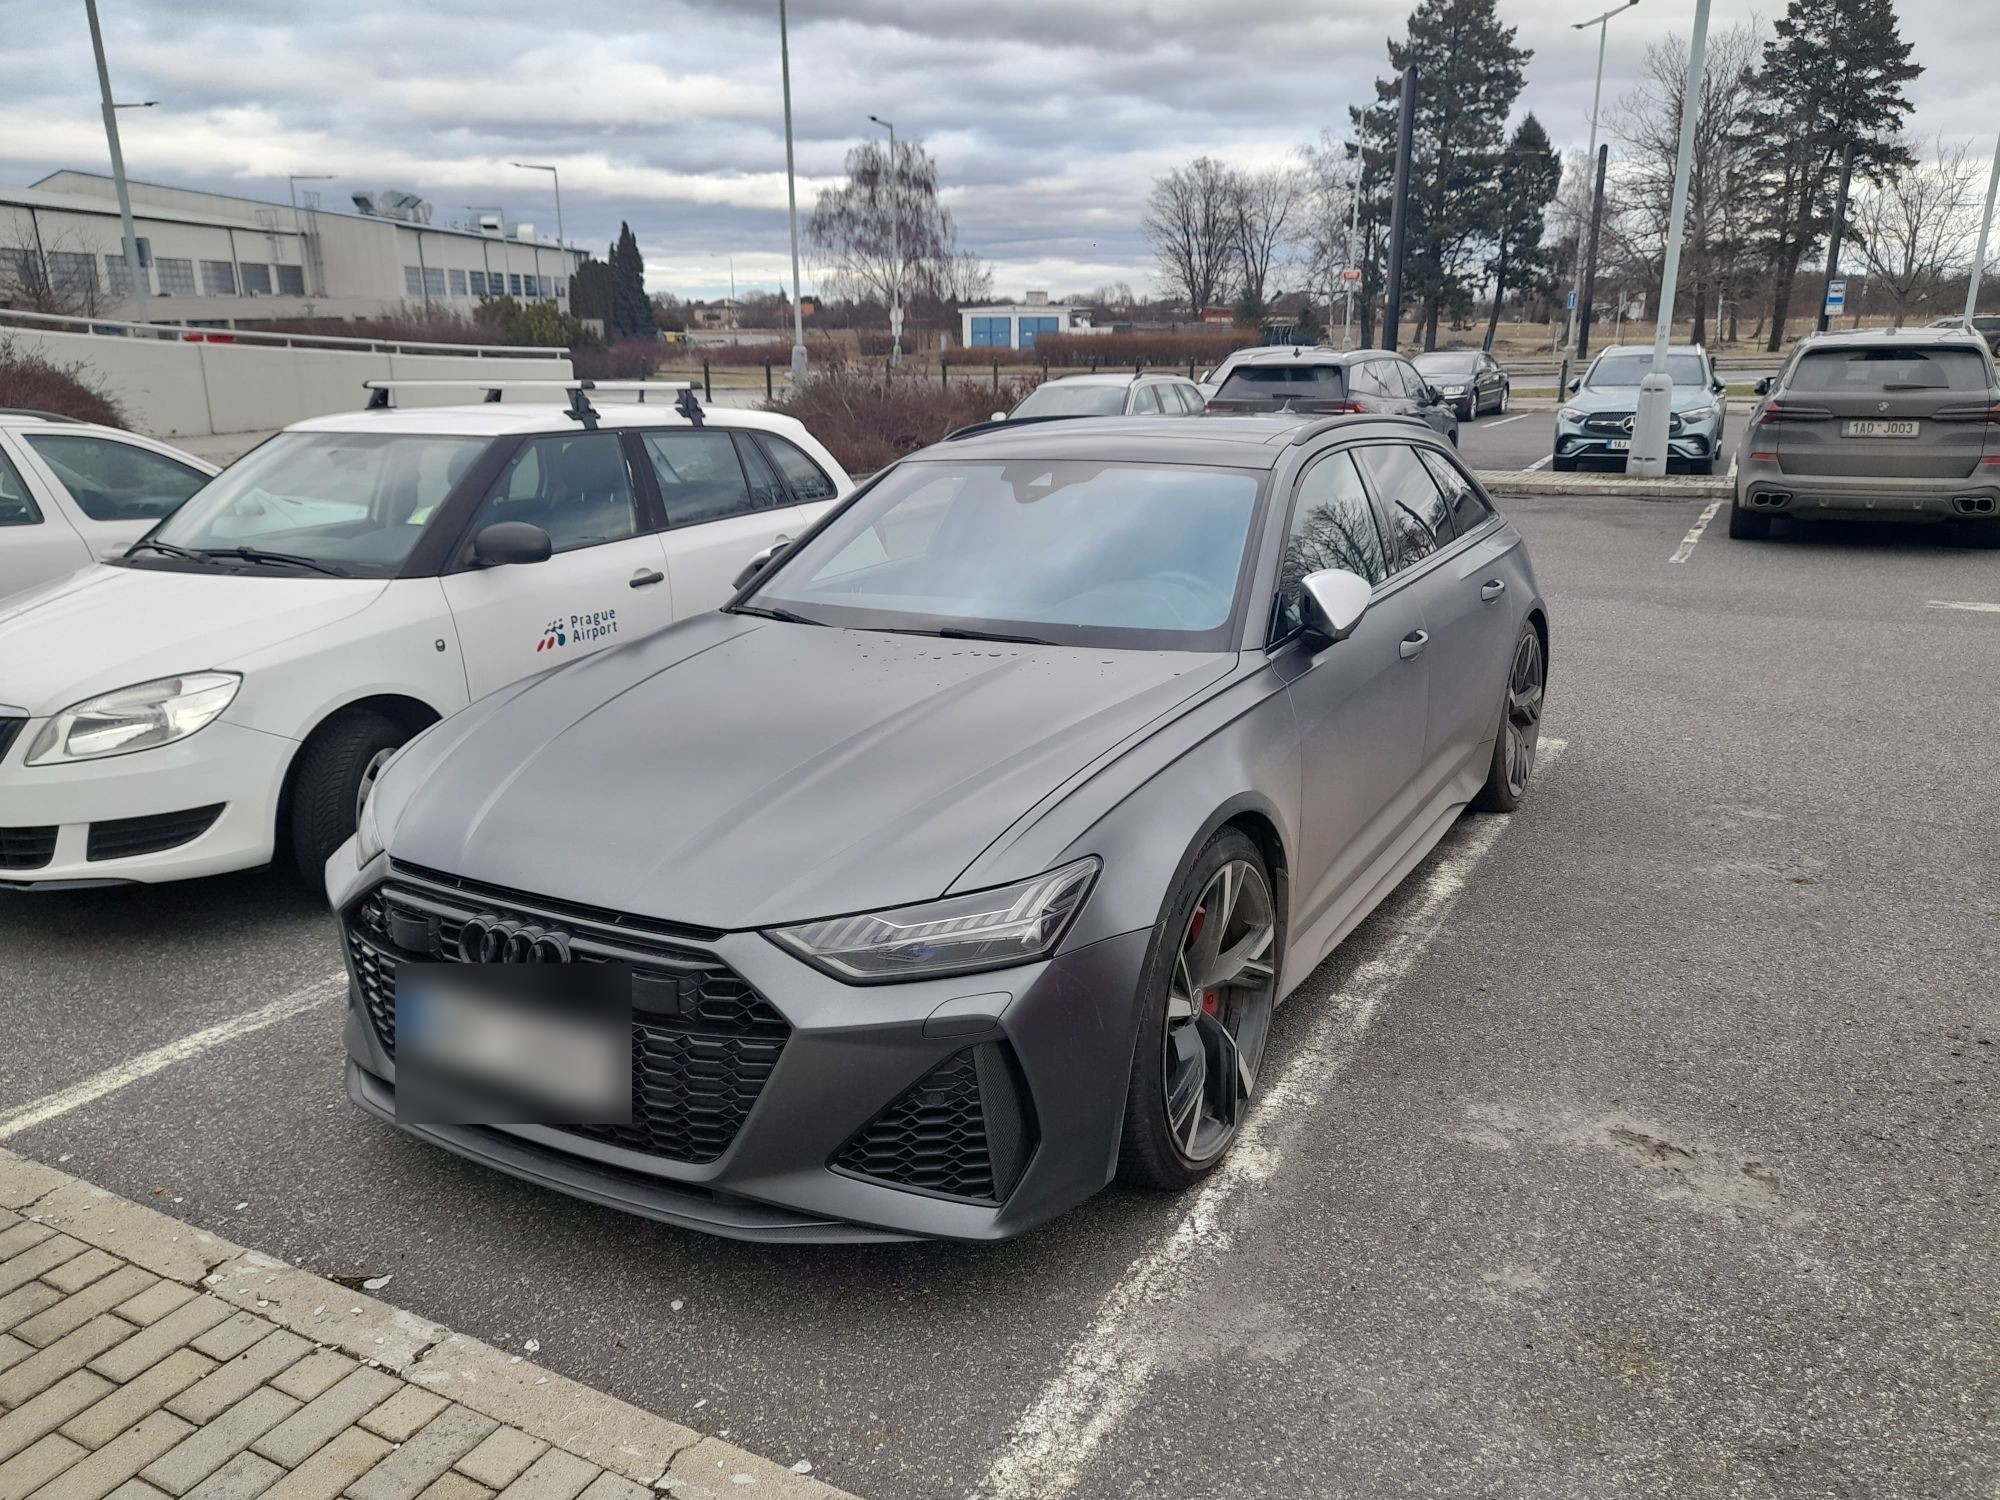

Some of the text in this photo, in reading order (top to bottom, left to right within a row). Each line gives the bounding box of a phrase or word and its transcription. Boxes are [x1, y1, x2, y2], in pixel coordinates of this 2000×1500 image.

[1883, 422, 1913, 434] J003
[570, 609, 616, 628] Prague
[573, 621, 618, 643] Airport
